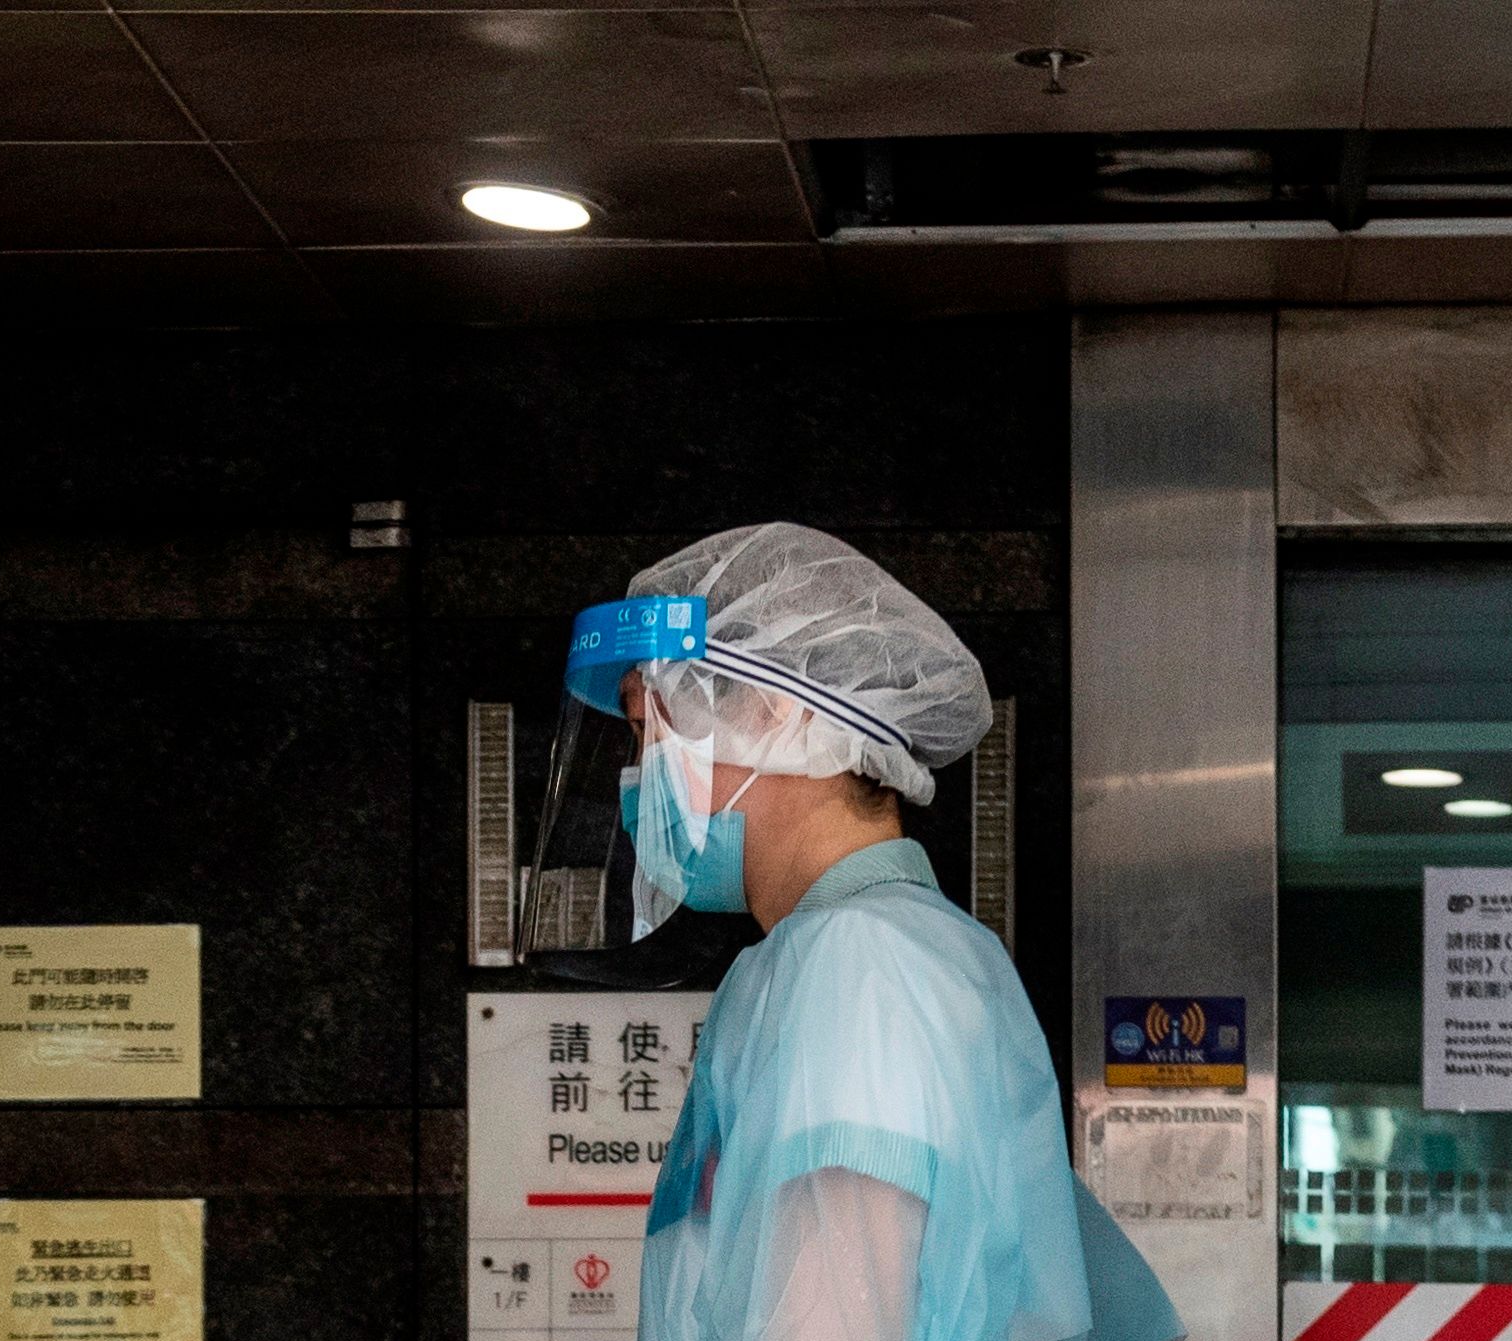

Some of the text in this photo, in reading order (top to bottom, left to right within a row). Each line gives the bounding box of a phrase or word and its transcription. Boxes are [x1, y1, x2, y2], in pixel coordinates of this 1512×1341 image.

[1445, 1018, 1491, 1031] Please
[548, 1070, 661, 1113] 前往
[548, 1133, 640, 1164] Please
[491, 1261, 530, 1283] 一樓
[494, 1291, 528, 1309] 1/F
